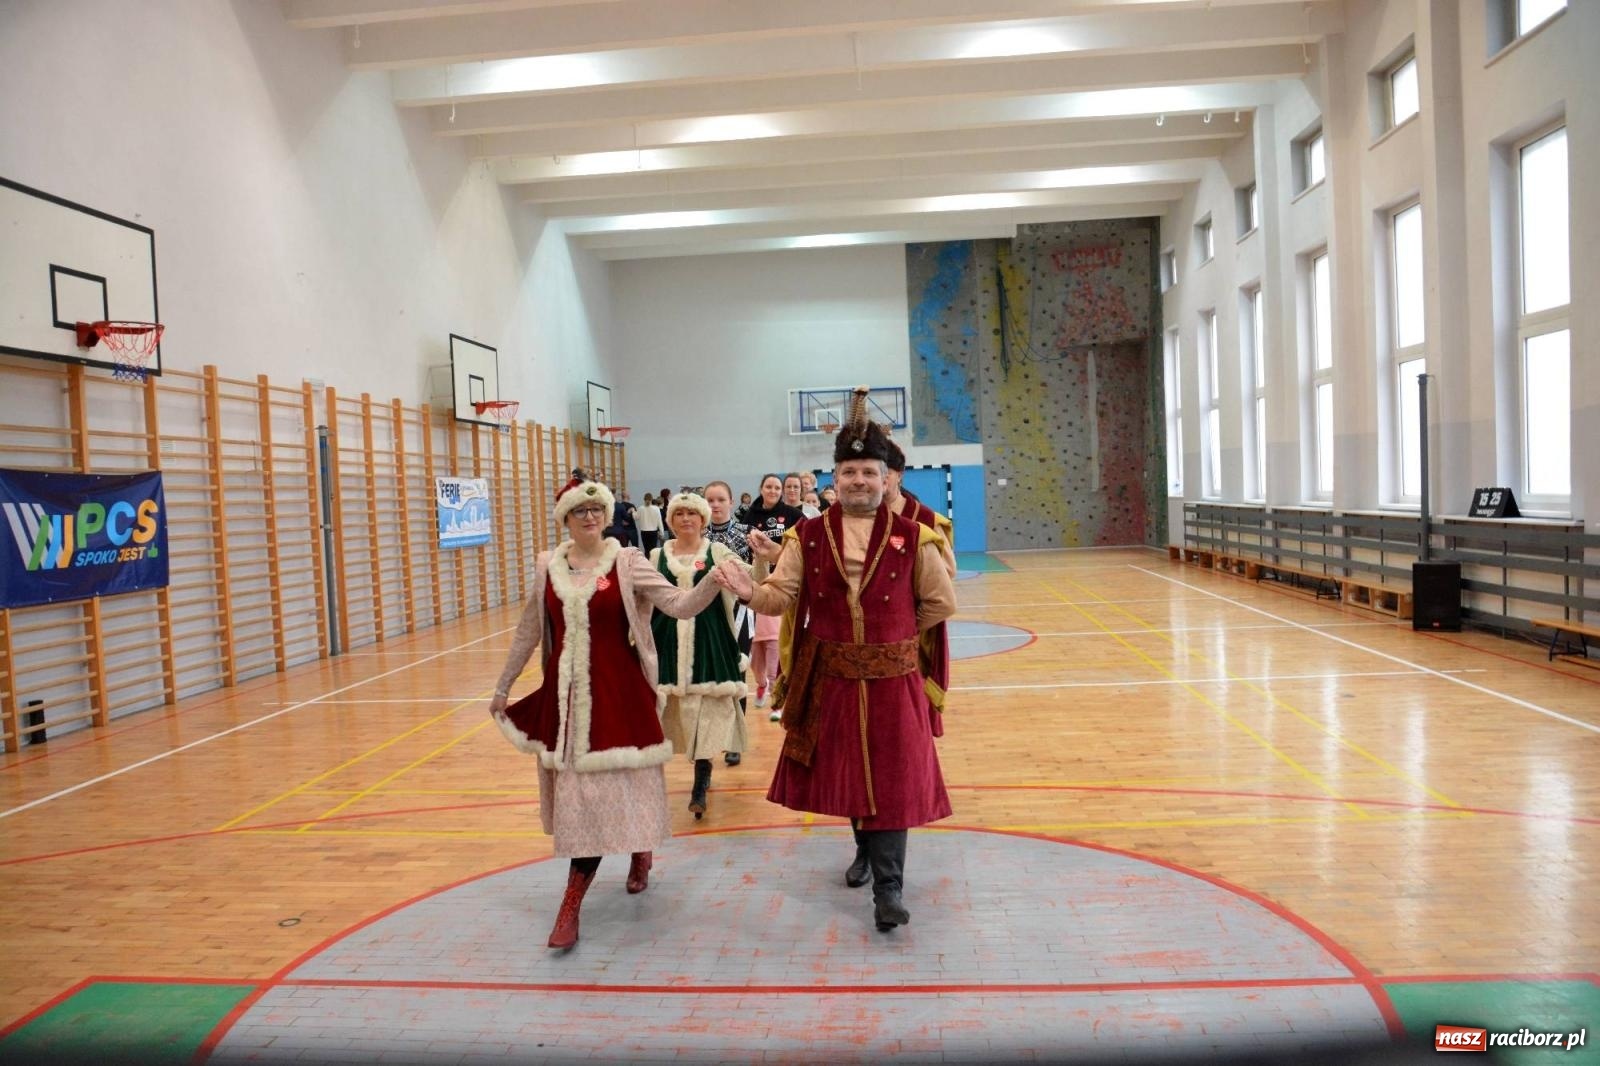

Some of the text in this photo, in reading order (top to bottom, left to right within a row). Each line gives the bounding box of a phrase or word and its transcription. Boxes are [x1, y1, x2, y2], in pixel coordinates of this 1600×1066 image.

[441, 483, 460, 498] FERIE
[1489, 491, 1502, 506] 25
[77, 499, 159, 549] PCS
[75, 546, 147, 567] SPOKO JEST
